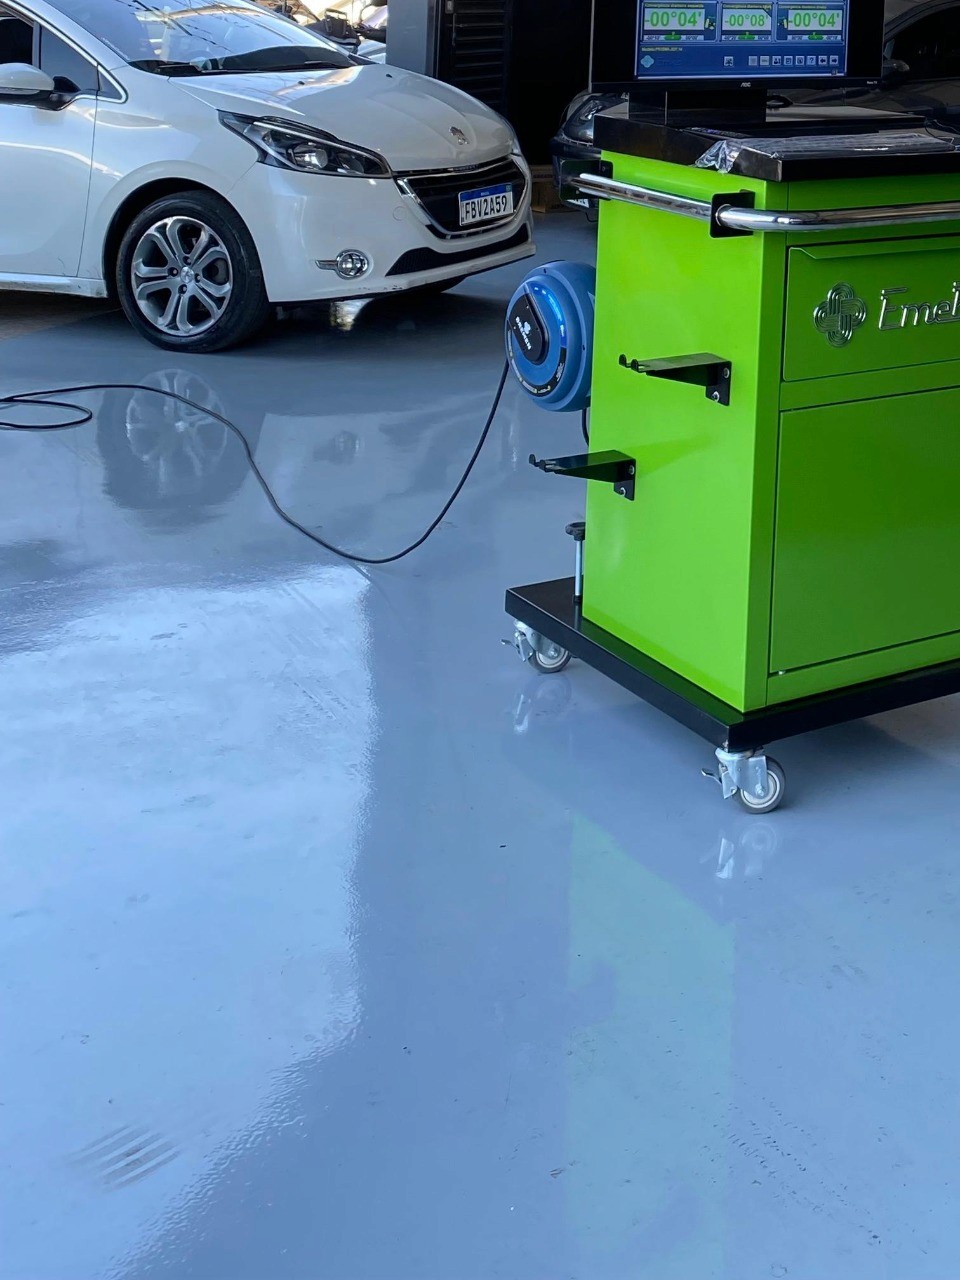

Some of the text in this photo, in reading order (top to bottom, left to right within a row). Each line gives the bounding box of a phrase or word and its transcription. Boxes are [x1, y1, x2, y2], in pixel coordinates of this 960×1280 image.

[645, 11, 702, 27] -00°04'
[789, 13, 840, 27] -00°04'
[465, 195, 507, 220] FBV2A59
